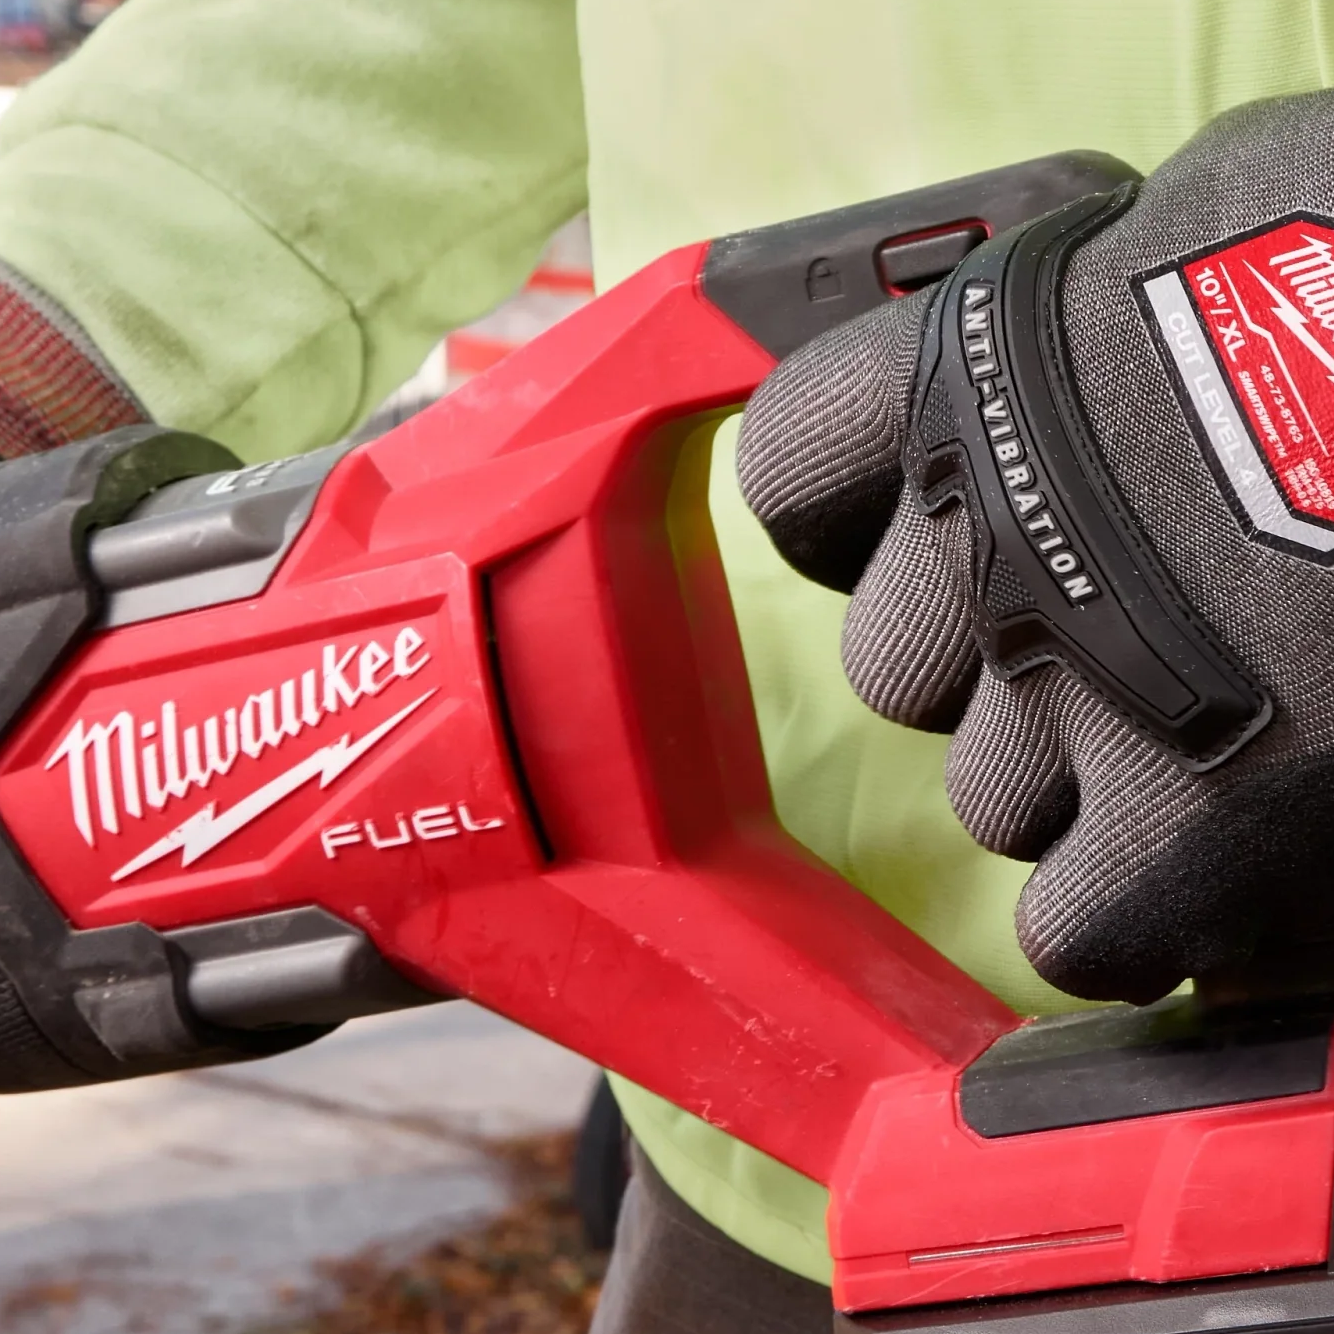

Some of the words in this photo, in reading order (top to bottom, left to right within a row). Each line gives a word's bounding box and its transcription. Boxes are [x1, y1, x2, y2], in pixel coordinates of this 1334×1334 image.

[1168, 312, 1204, 365] CUT
[1193, 372, 1242, 463] LEVEL
[1240, 468, 1256, 485] 4
[1218, 319, 1246, 363] XL
[1260, 364, 1303, 444] 48-73-8763
[965, 287, 1093, 601] ANTI-VIBRATION
[45, 626, 431, 848] Milwaukee
[319, 800, 505, 859] FUEL
